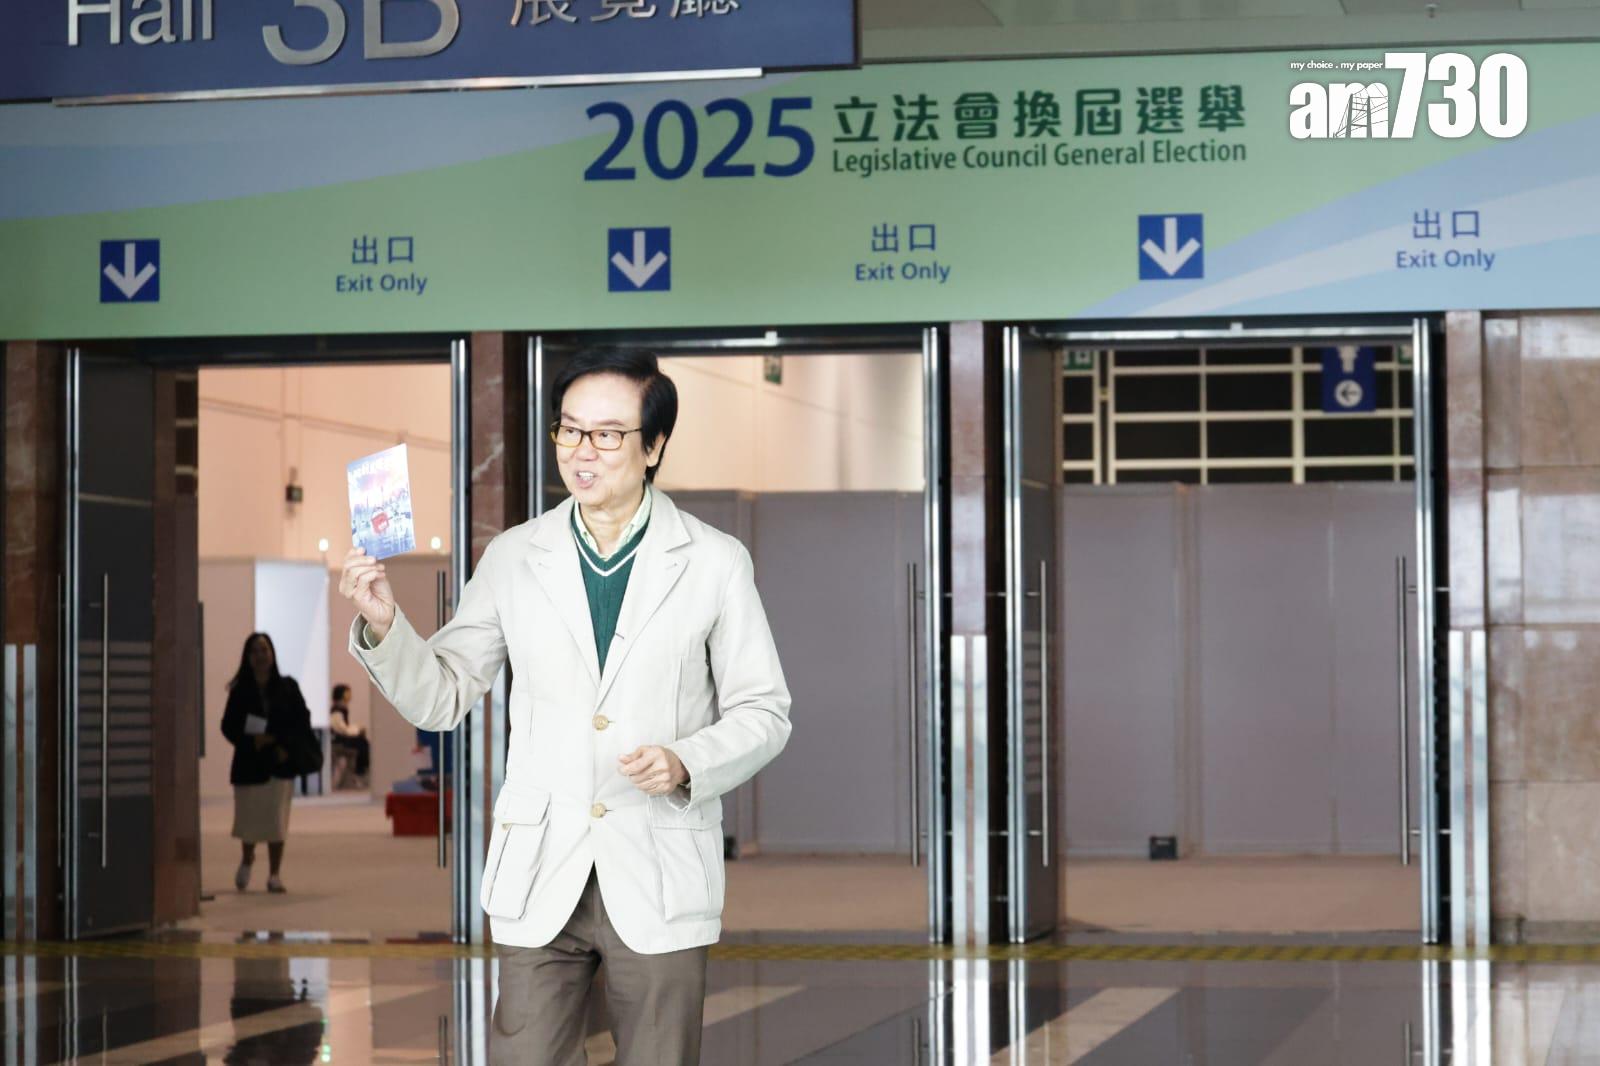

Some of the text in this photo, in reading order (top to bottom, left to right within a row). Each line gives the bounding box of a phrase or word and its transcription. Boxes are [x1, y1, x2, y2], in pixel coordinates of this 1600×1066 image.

[67, 0, 214, 46] Hall
[833, 84, 1246, 142] 立法會換屆選舉
[584, 97, 815, 181] 2025
[833, 138, 1247, 178] Legislative Council General Election
[872, 222, 936, 253] 出口
[1413, 208, 1479, 240] 出口
[352, 235, 414, 264] 出口
[1396, 247, 1496, 272] Exit Only
[336, 272, 428, 295] Exit Only
[855, 260, 951, 284] Exit Only
